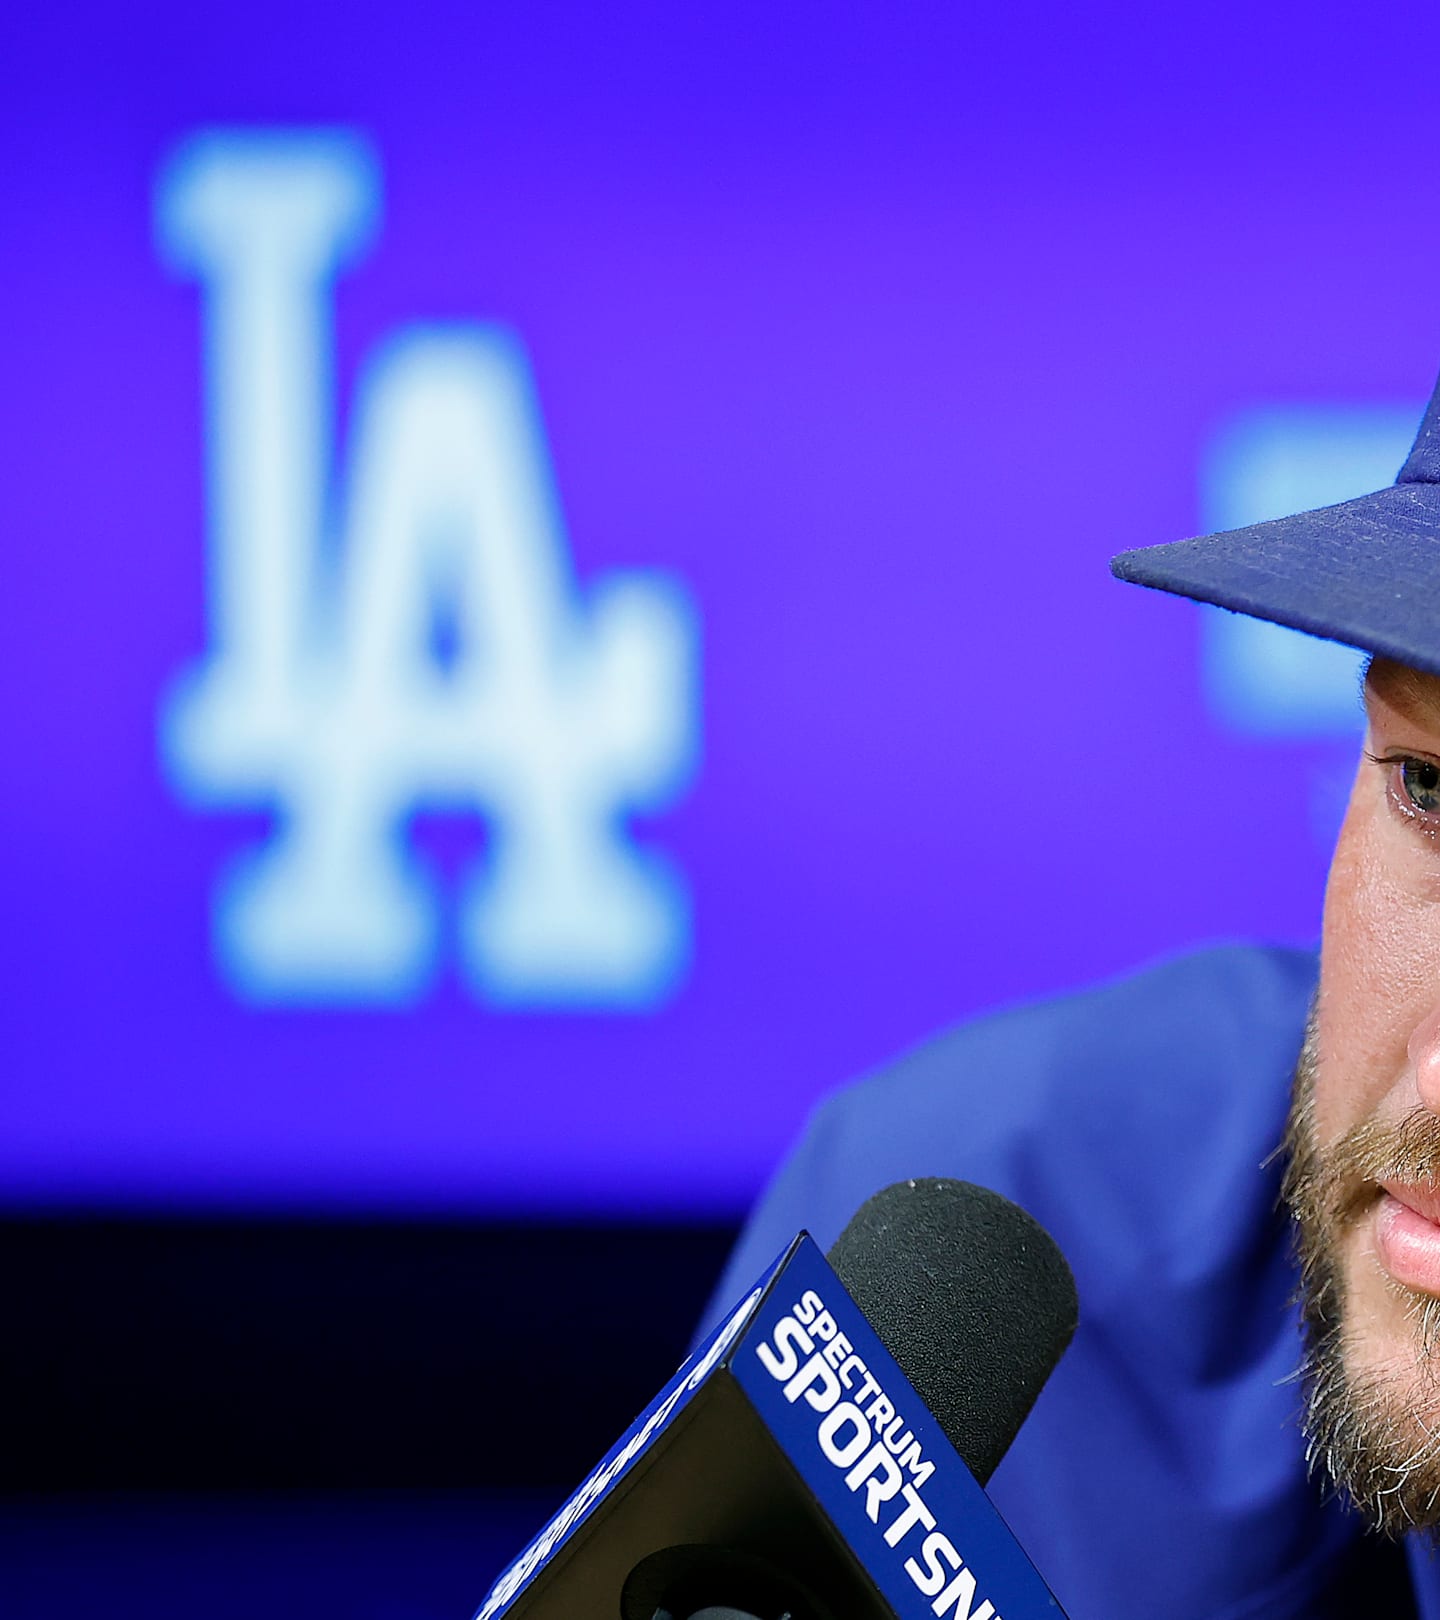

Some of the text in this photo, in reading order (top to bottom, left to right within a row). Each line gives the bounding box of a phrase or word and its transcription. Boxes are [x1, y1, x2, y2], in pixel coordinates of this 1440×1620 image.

[154, 128, 702, 1012] LA
[755, 1315, 1002, 1620] SPORTSN
[793, 1290, 936, 1489] SPECTRUM
